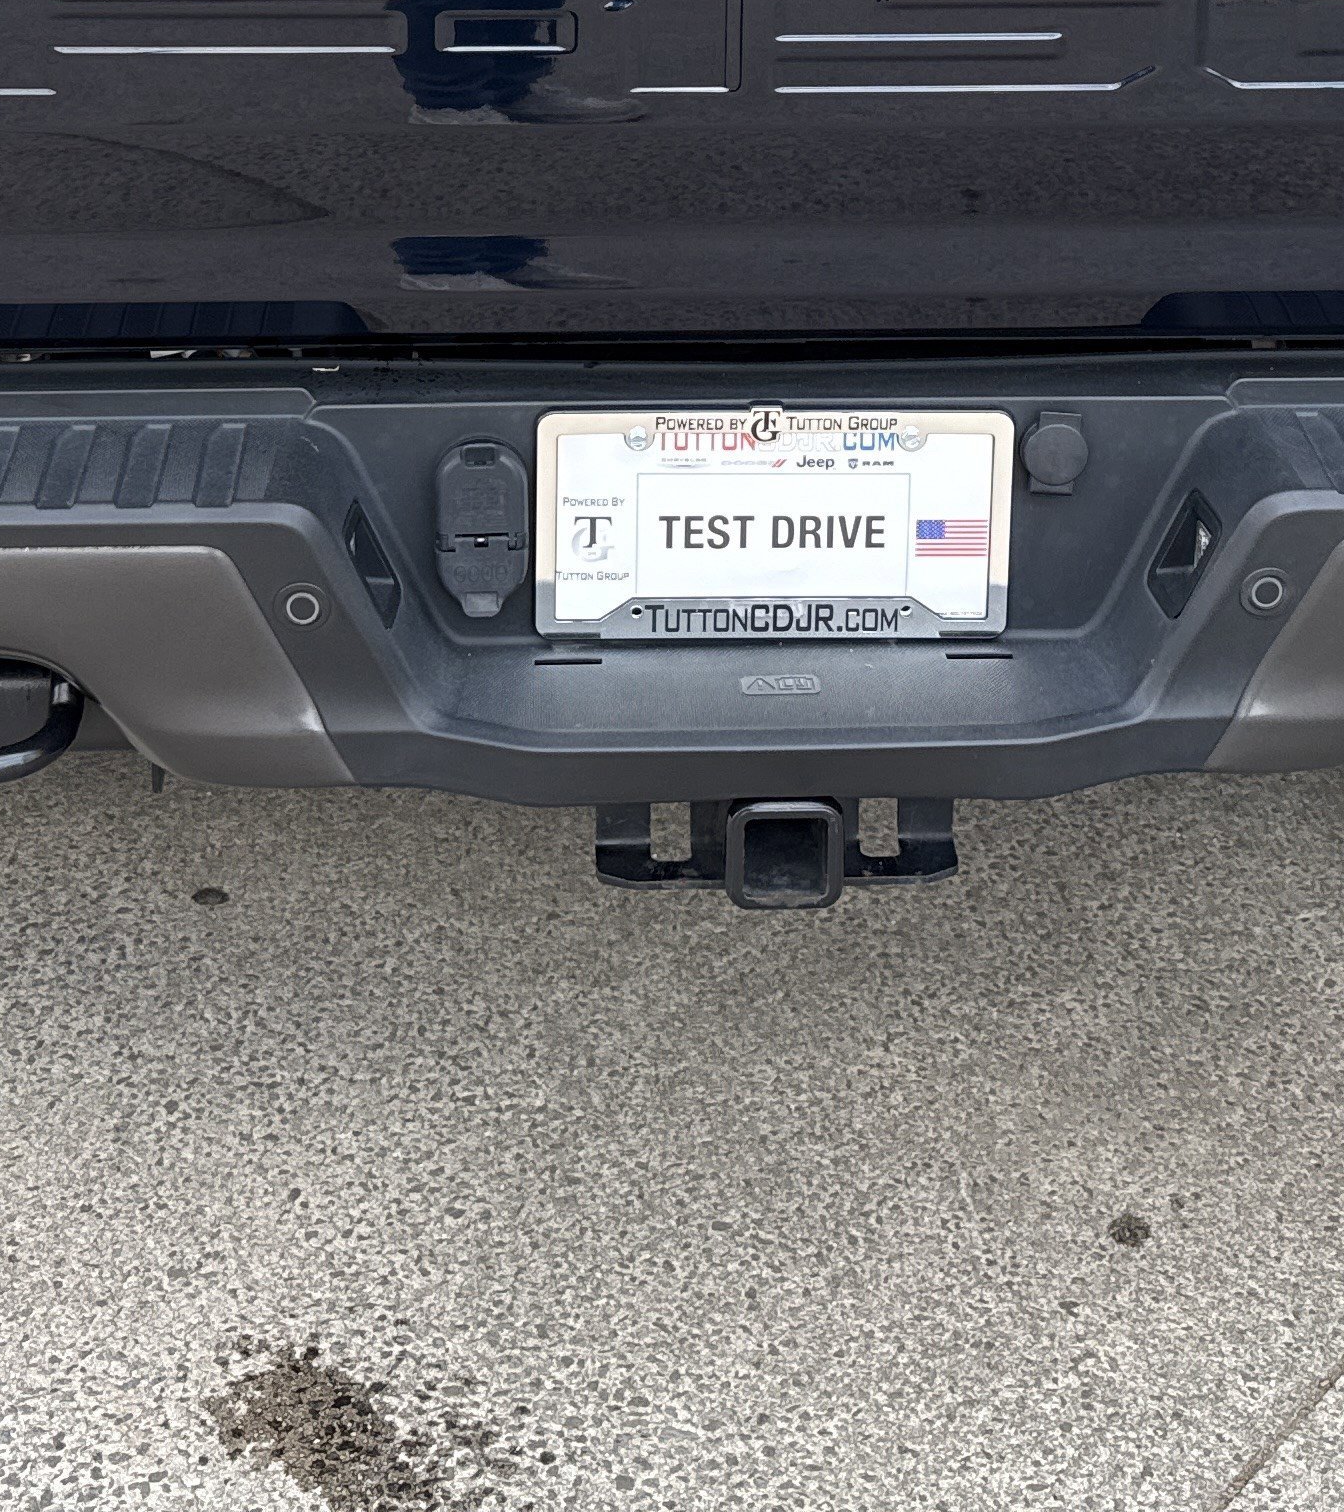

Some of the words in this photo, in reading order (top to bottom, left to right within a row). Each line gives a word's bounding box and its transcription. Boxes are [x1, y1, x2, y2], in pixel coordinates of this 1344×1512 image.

[730, 417, 747, 431] BY
[786, 416, 842, 431] TUTTON
[848, 416, 898, 432] GROUP
[796, 455, 835, 470] Jeep
[659, 515, 754, 549] TEST
[771, 515, 886, 549] DRIVE
[596, 570, 630, 581] GROUP
